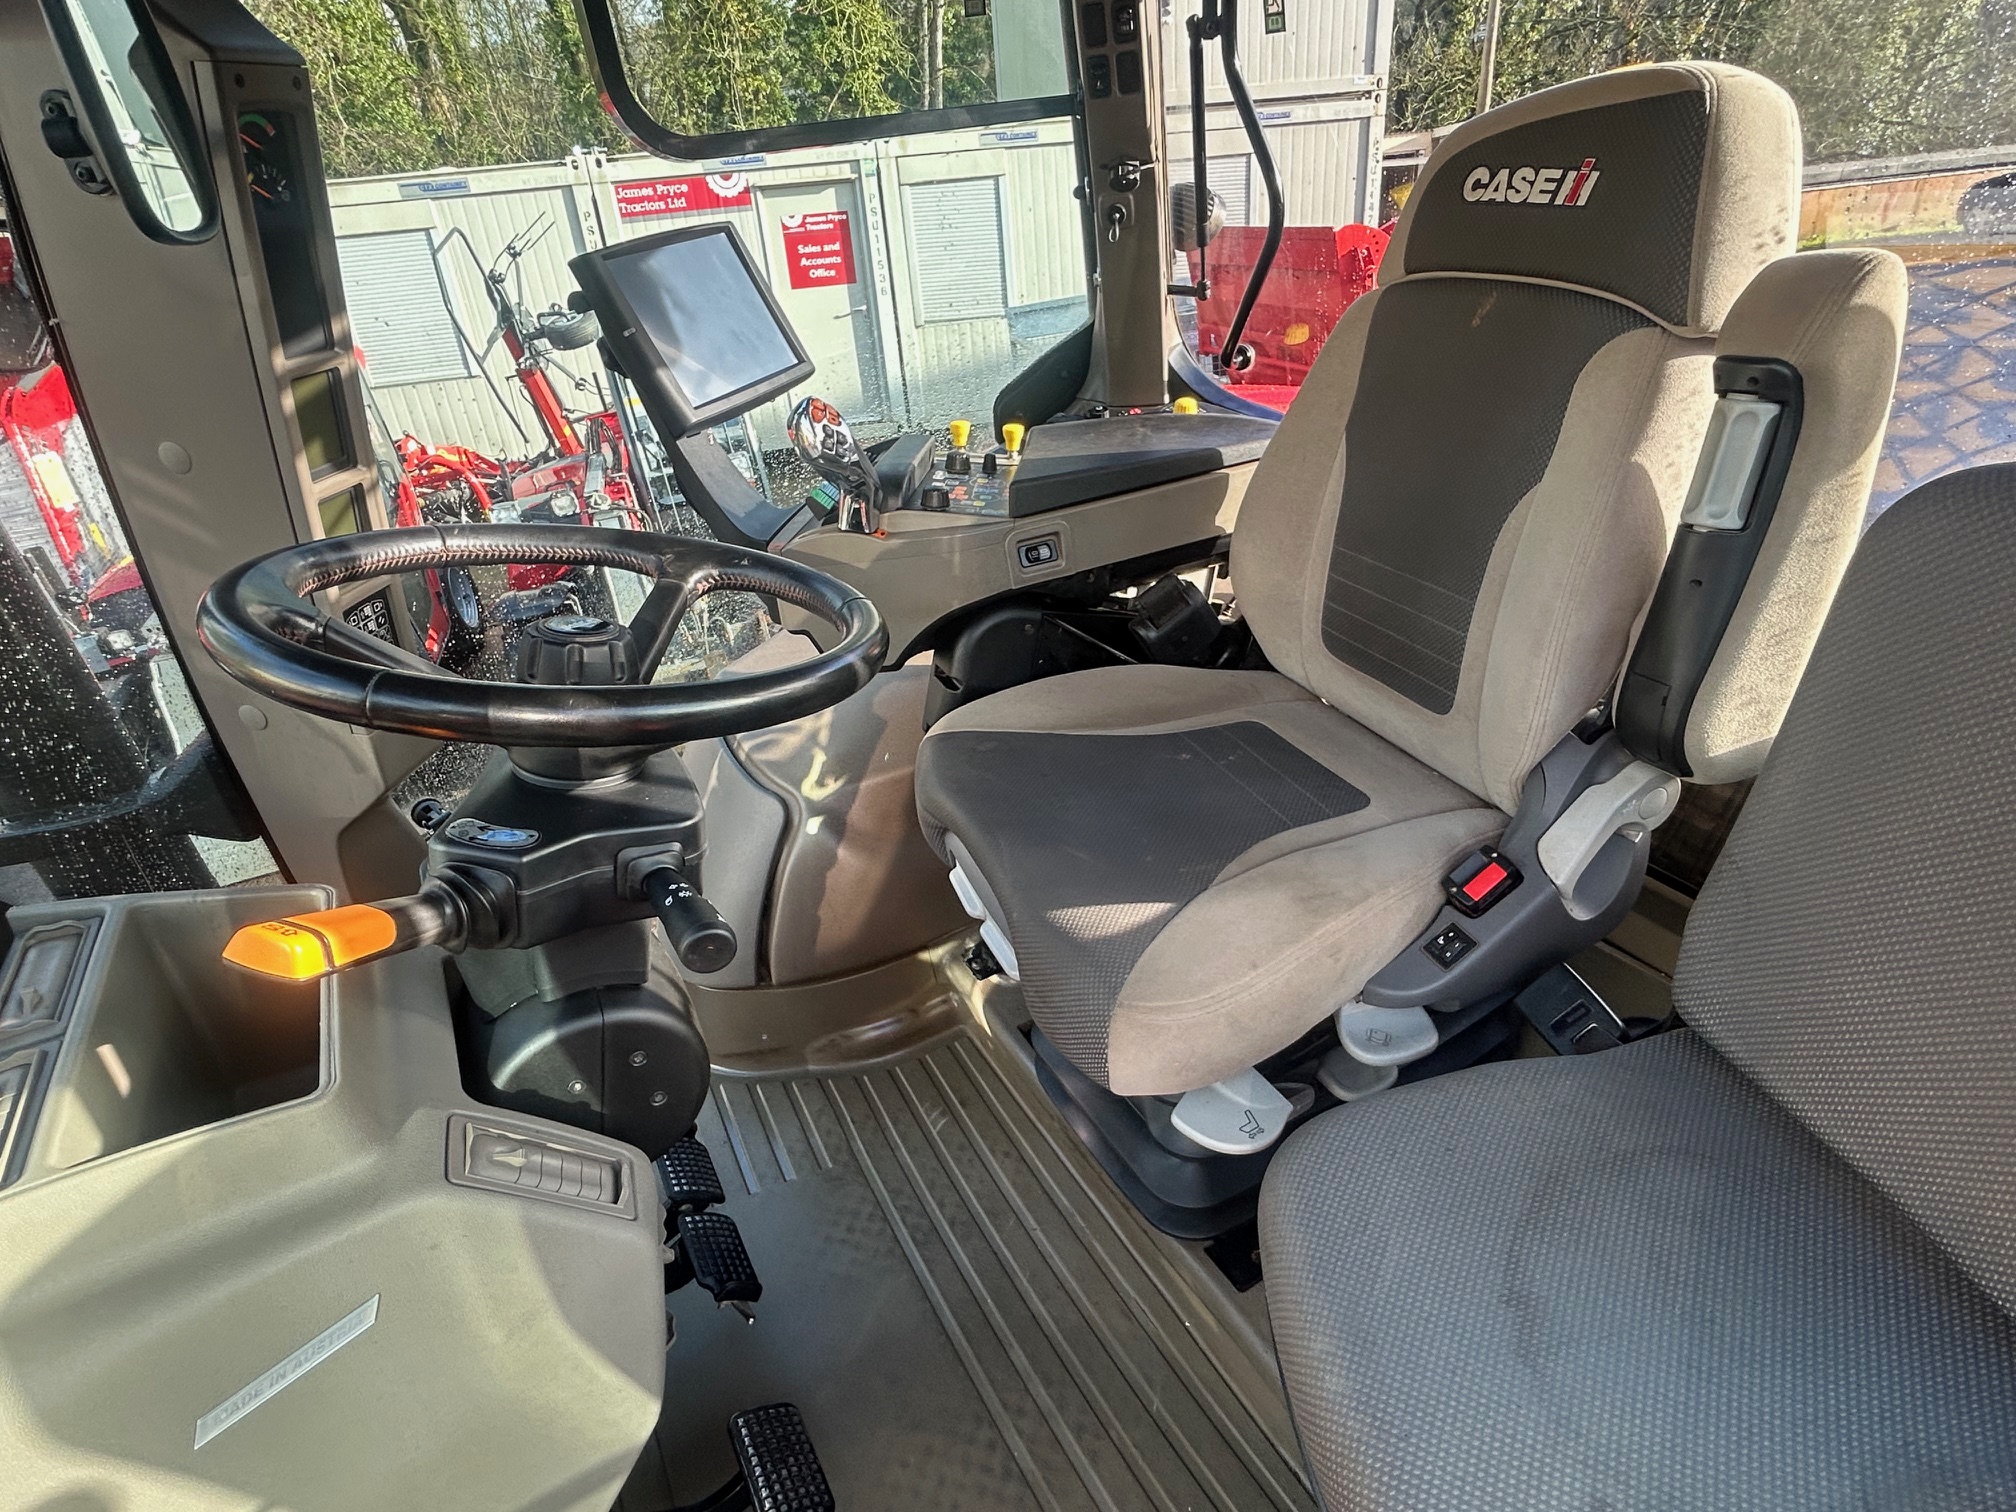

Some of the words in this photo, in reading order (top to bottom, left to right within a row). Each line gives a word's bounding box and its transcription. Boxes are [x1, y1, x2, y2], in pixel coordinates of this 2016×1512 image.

[617, 186, 654, 199] James
[655, 183, 688, 196] Pryce
[619, 200, 666, 213] Tractors
[667, 197, 687, 209] Ltd
[797, 244, 821, 254] Sales
[823, 241, 840, 251] and
[800, 256, 842, 266] Accounts
[809, 268, 836, 278] Office
[269, 1371, 288, 1389] IN
